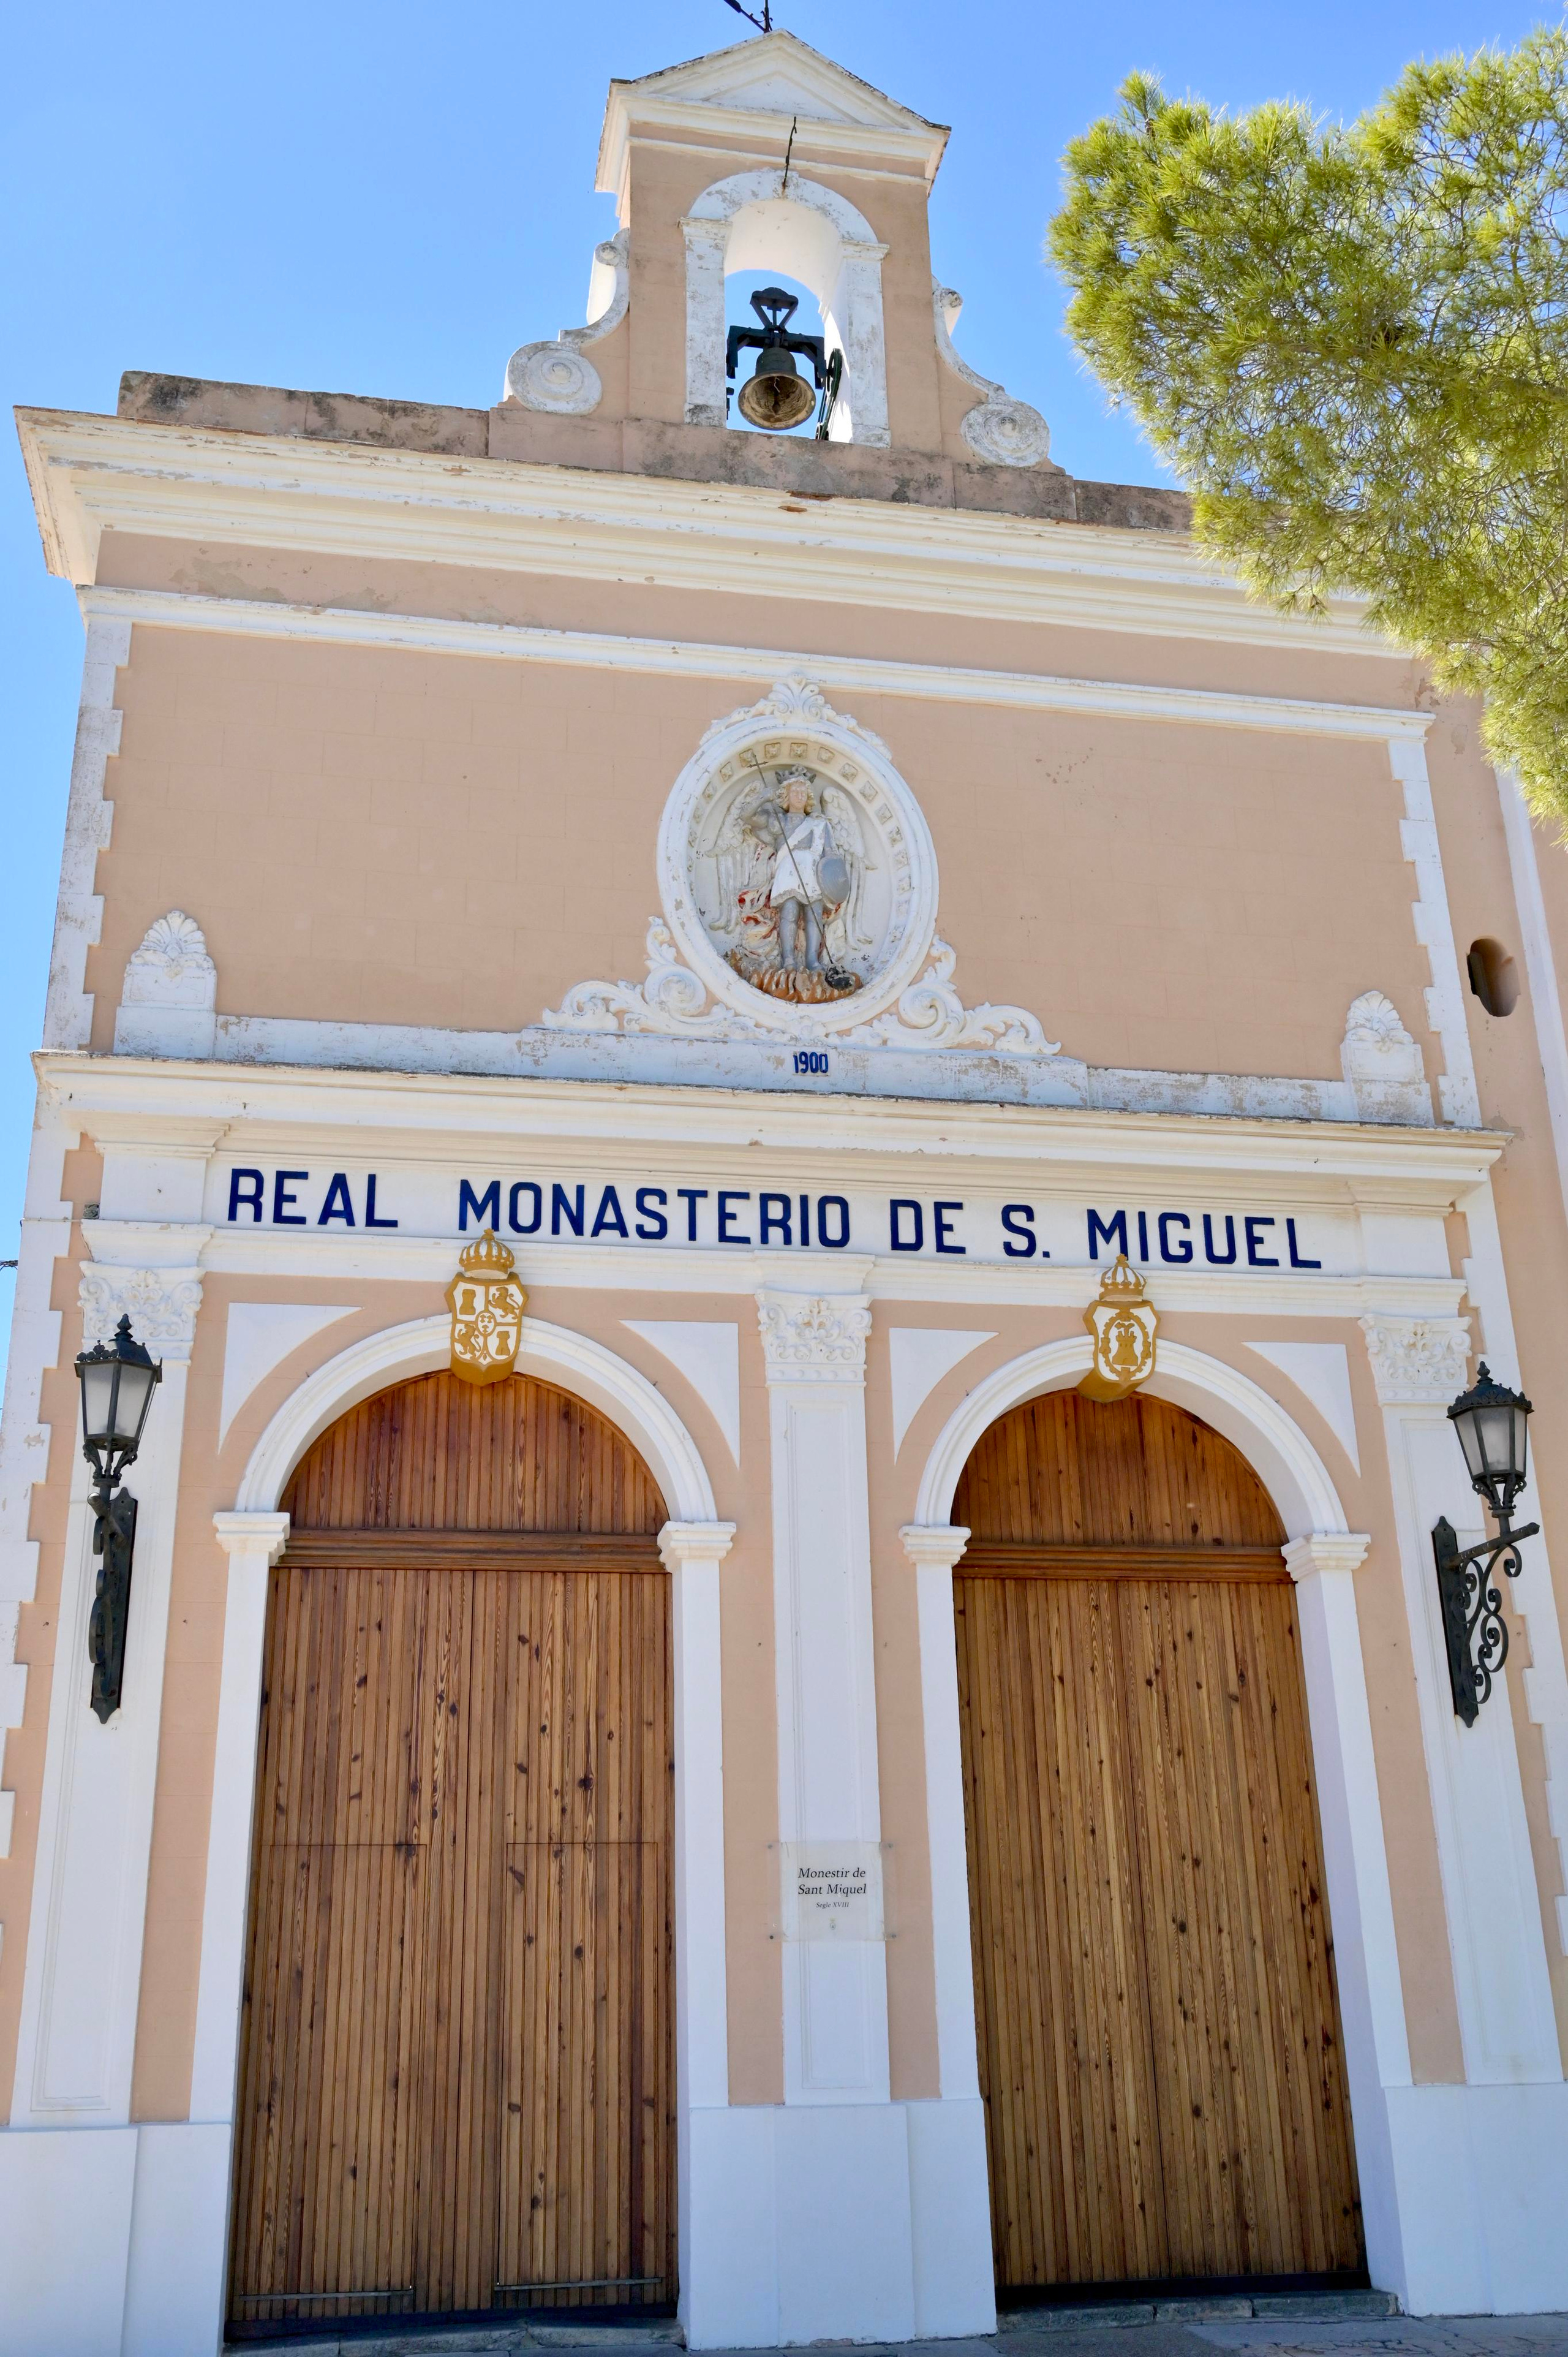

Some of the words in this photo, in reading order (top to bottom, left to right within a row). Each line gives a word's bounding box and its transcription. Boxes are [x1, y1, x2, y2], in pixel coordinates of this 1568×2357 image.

[793, 1051, 829, 1074] 1900
[227, 1168, 398, 1228] REAL
[458, 1179, 851, 1249] MONASTERIO
[889, 1199, 967, 1255] DE
[1001, 1204, 1051, 1259] S.
[1087, 1209, 1322, 1269] MIGUEL
[797, 1867, 850, 1878] Monestir
[853, 1867, 866, 1878] de
[798, 1884, 823, 1895] Sant
[827, 1883, 867, 1897] Miquel
